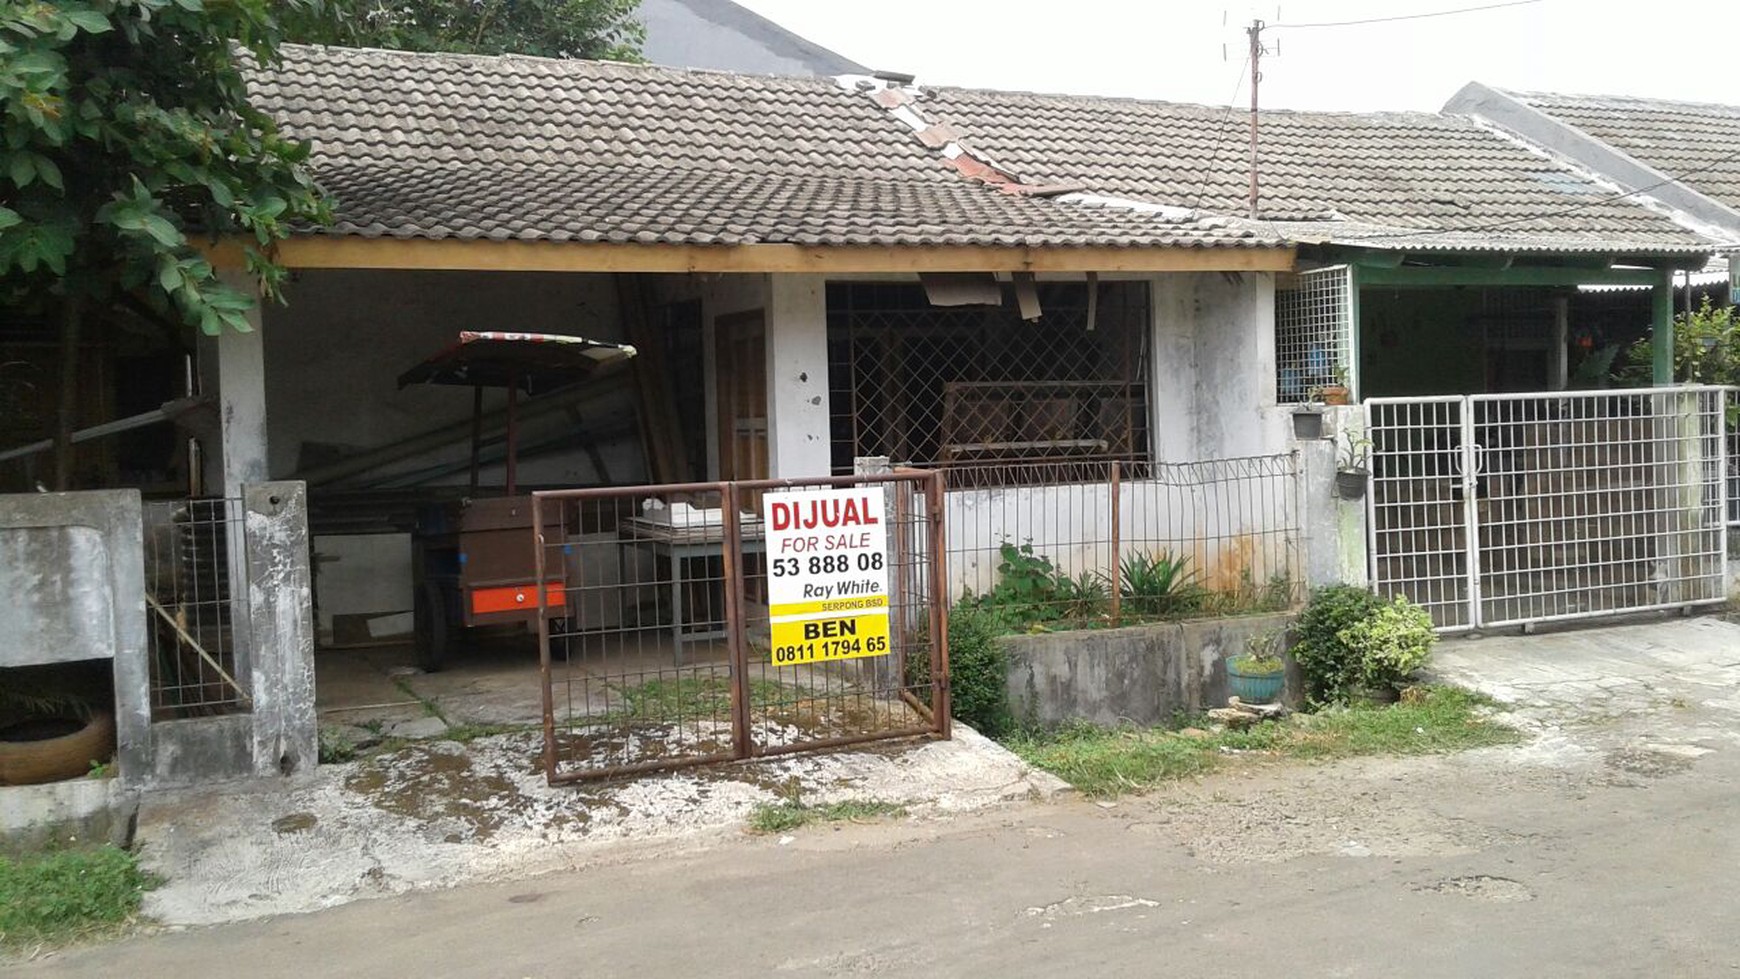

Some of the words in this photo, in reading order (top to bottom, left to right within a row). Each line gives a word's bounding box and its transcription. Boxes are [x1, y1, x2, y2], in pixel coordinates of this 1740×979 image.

[772, 497, 878, 531] DIJUAL
[781, 536, 819, 553] FOR
[824, 532, 871, 550] SALE
[773, 557, 800, 577] 53
[809, 554, 849, 574] 888
[857, 552, 883, 571] 08
[803, 583, 834, 599] Ray
[822, 600, 864, 611] SERPONG
[866, 598, 883, 607] BSD
[804, 619, 856, 640] BEN
[776, 643, 814, 662] 0811
[822, 638, 861, 656] 1794
[866, 636, 886, 652] 65
